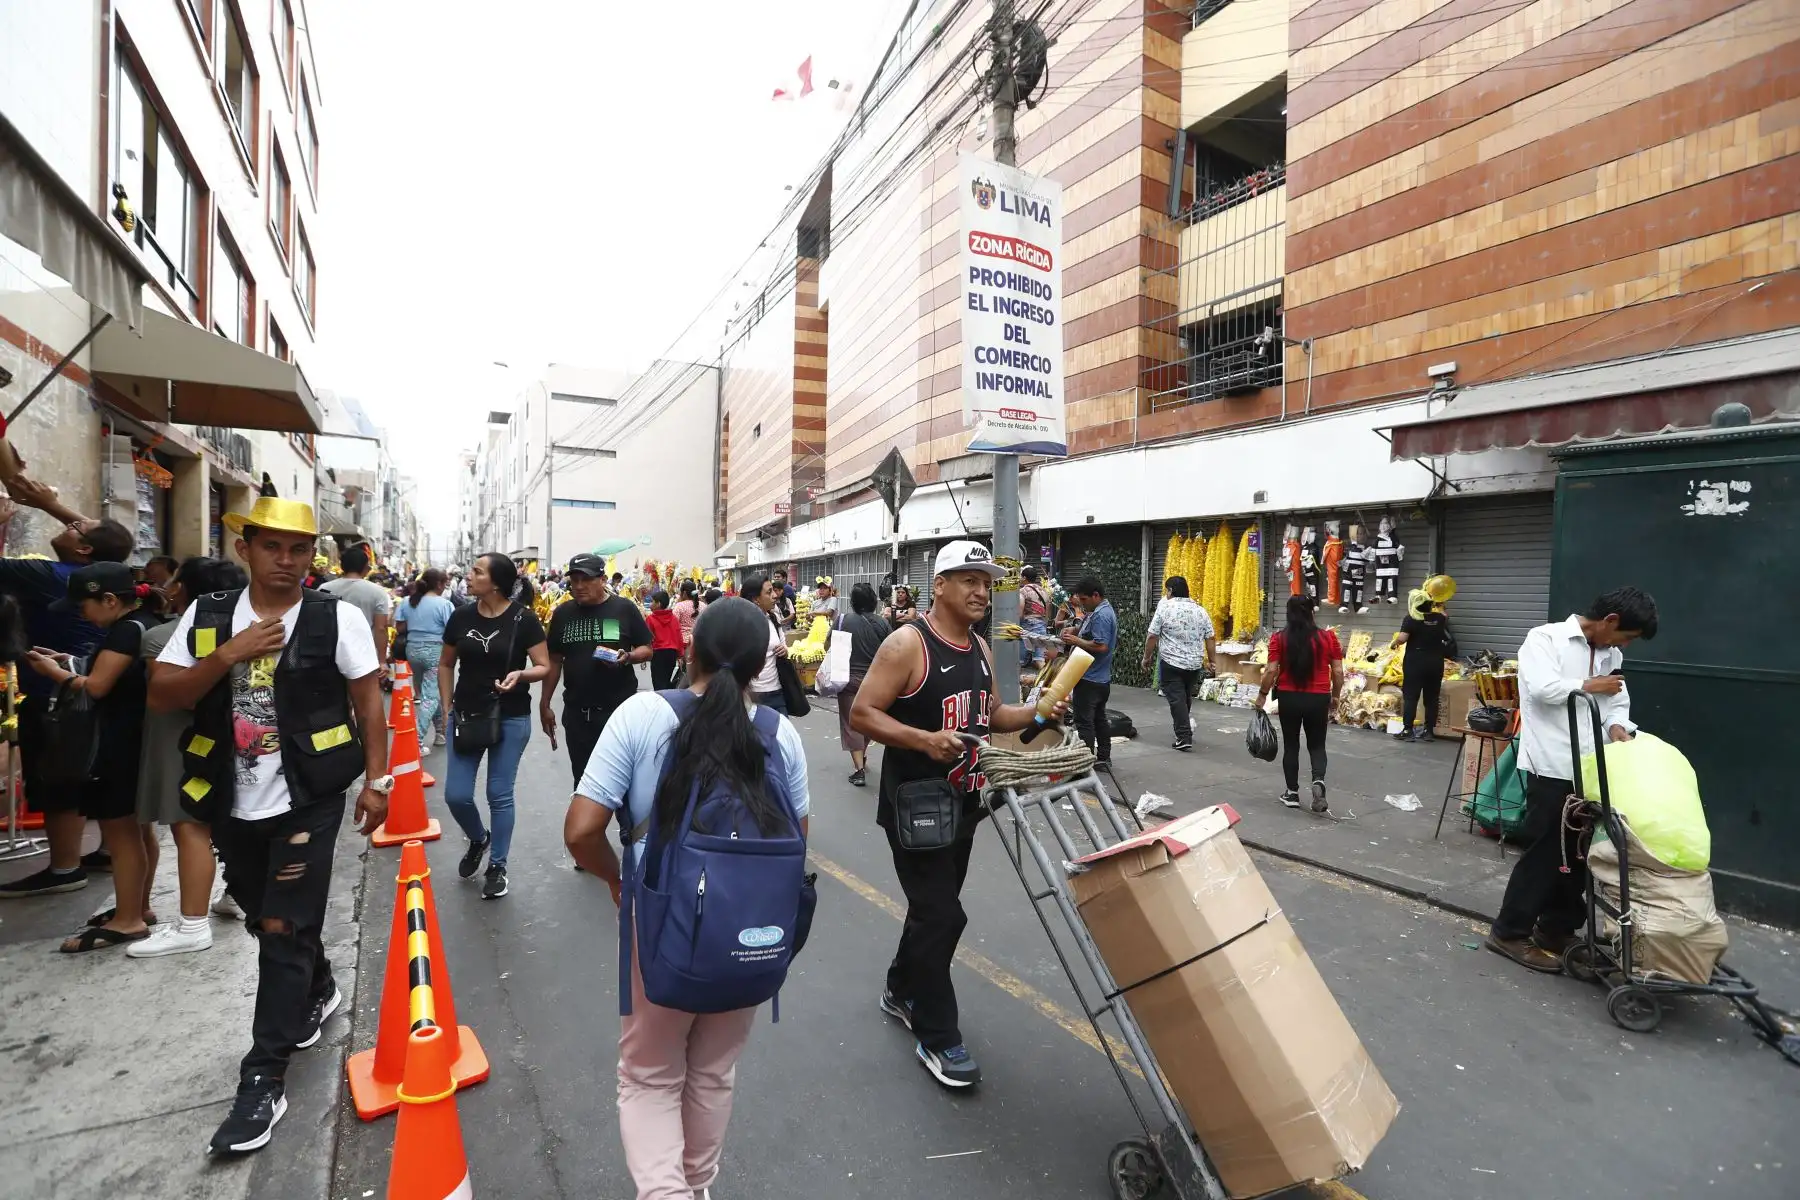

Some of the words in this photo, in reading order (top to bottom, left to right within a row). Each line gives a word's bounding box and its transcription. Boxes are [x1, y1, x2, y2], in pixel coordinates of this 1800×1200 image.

[1000, 190, 1052, 228] LIMA
[971, 235, 1013, 256] ZONA
[1015, 242, 1051, 269] RÍGIDA
[969, 266, 1052, 301] PROHIBIDO
[968, 291, 989, 312] EL
[993, 295, 1055, 327] INGRESO
[1003, 322, 1031, 346] DEL
[974, 345, 1052, 375] COMERCIO
[975, 371, 1053, 399] INFORMAL
[1001, 410, 1016, 418] BASE
[1017, 411, 1034, 420] LEGAL
[969, 546, 989, 559] NIKE
